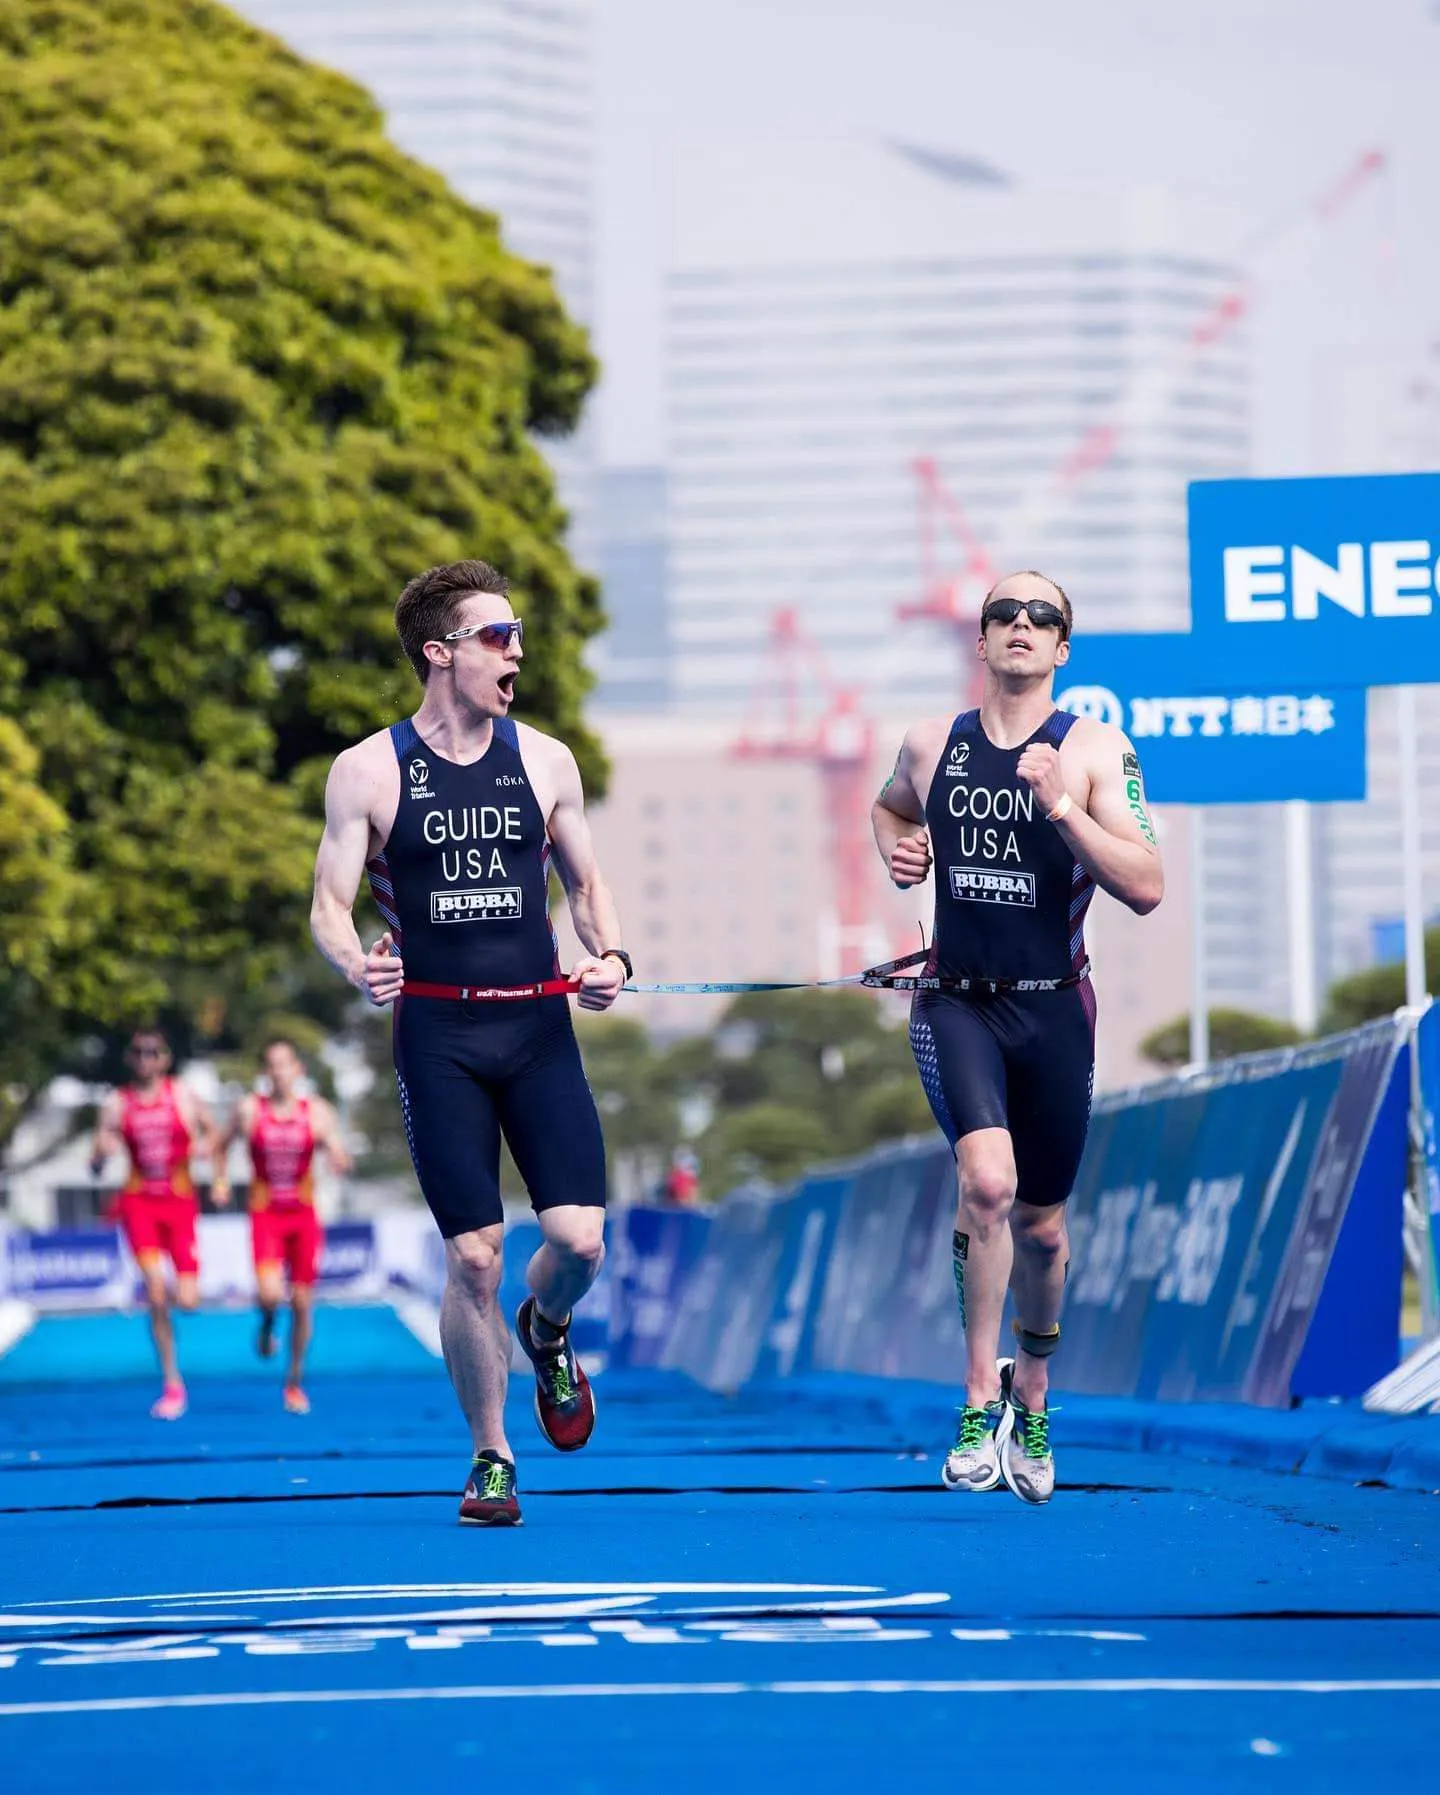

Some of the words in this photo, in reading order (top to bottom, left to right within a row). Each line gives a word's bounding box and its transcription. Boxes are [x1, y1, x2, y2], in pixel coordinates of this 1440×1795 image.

[1223, 539, 1440, 622] ENE
[1130, 697, 1229, 738] NTT
[949, 785, 1033, 822] COON
[423, 806, 522, 844] GUIDE
[960, 826, 1022, 862] USA
[441, 848, 508, 881] USA
[954, 873, 1030, 894] BUBBA
[957, 887, 1027, 902] burger
[437, 893, 517, 912] BUBBA
[440, 908, 514, 921] burger
